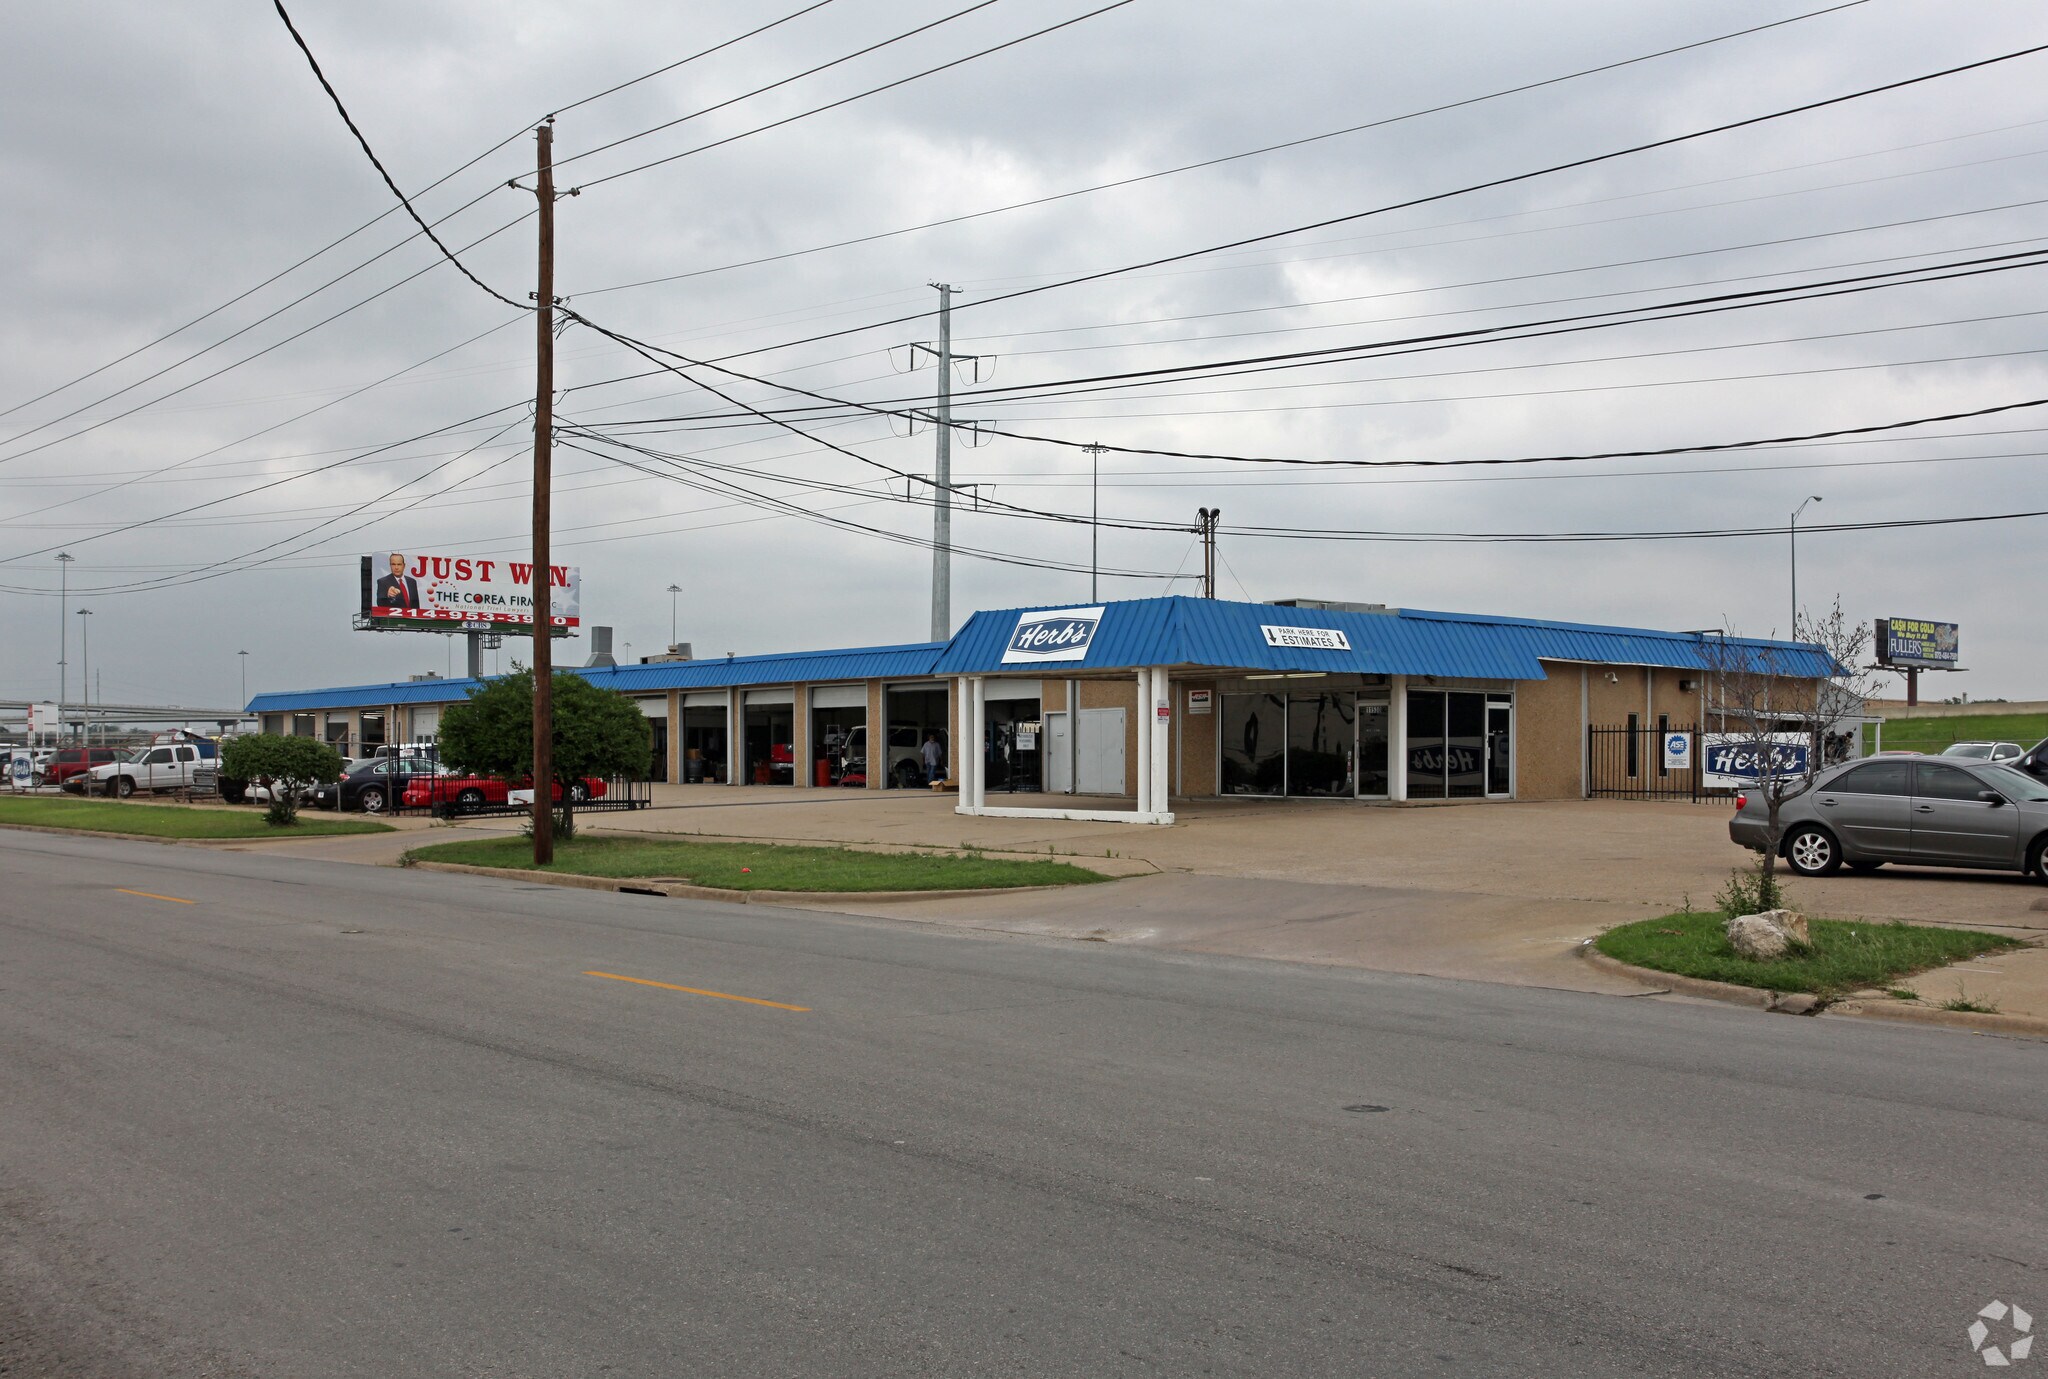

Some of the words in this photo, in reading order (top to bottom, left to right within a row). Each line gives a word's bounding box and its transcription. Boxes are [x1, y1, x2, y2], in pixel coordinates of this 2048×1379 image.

[411, 556, 495, 582] JUST
[509, 563, 571, 587] WN.
[436, 591, 459, 602] THE
[464, 593, 506, 605] COREA
[389, 607, 567, 625] 214-953-390
[1907, 621, 1919, 632] FOR
[1920, 622, 1935, 634] GOLD
[1018, 622, 1087, 649] Herb's
[1282, 635, 1334, 647] ESTIMATES
[1670, 740, 1684, 748] ASE
